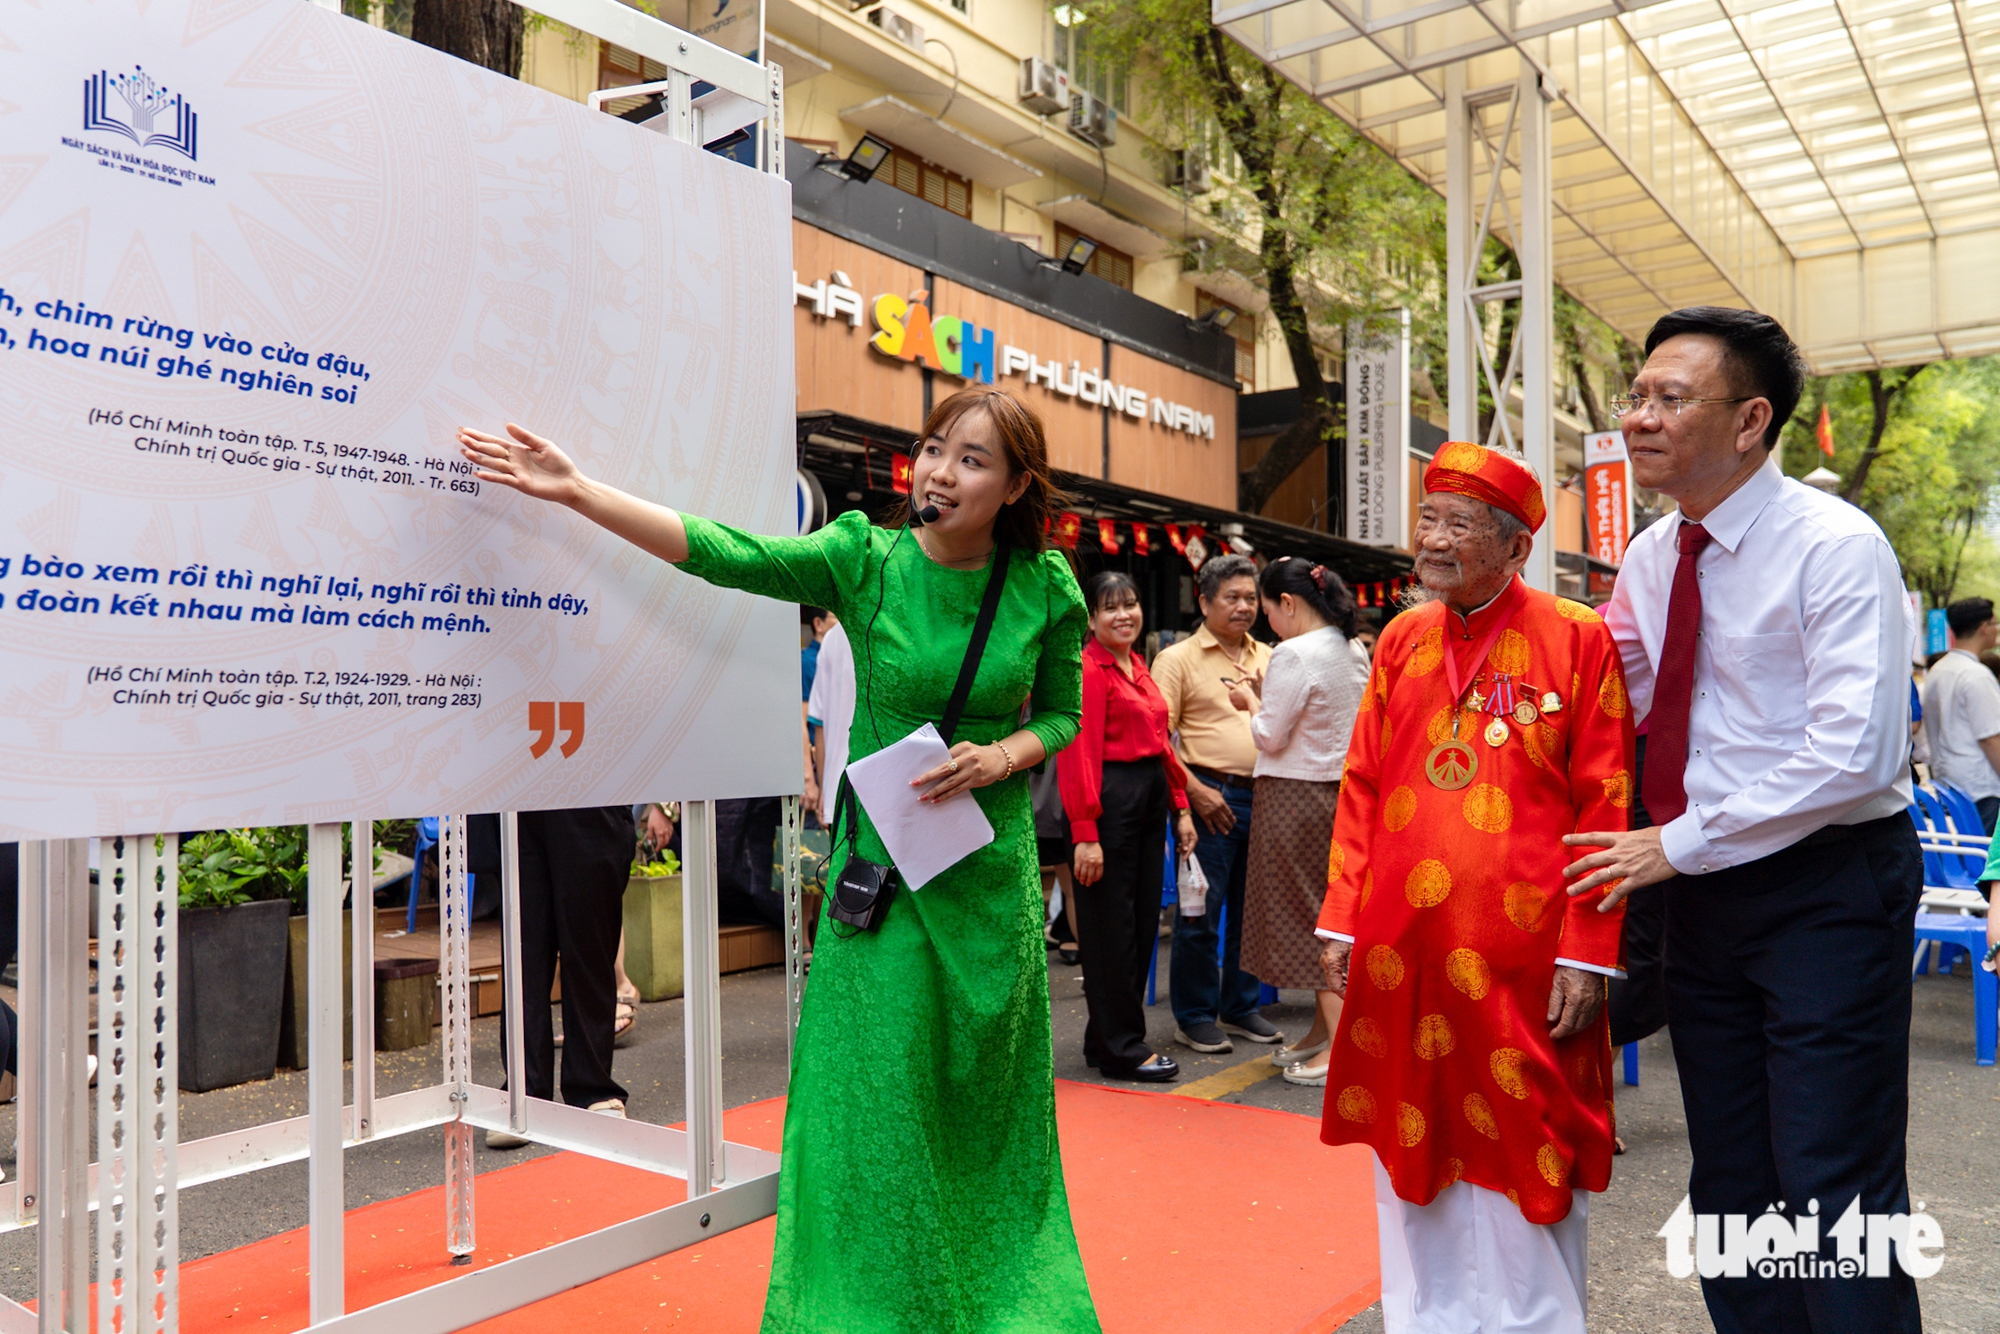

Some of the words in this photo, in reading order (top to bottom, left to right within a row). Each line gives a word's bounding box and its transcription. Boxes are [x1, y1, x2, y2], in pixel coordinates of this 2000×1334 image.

[61, 136, 84, 150] NGÀY
[86, 142, 109, 157] SÁCH
[111, 150, 123, 160] VÀ
[124, 153, 141, 166] VĂN
[143, 158, 160, 171] HÓA
[162, 164, 178, 176] ĐỌC
[179, 168, 197, 181] VIỆT
[198, 174, 216, 186] NAM
[34, 298, 115, 331] chim
[122, 315, 195, 350] rừng
[202, 331, 254, 357] vào
[260, 341, 310, 368] cửa
[316, 352, 371, 383] đậu,
[793, 270, 864, 328] HÀ
[869, 289, 995, 386] SÁCH
[999, 344, 1147, 419] PHƯƠNG
[1150, 396, 1215, 440] NAM
[26, 327, 92, 360] hoa
[99, 345, 151, 370] núi
[155, 354, 213, 380] ghé
[219, 367, 314, 398] nghiên
[320, 384, 359, 405] soi
[1374, 361, 1385, 401] HOUSE
[88, 407, 124, 426] (Hồ
[128, 414, 164, 432] Chí
[166, 419, 214, 439] Minh
[218, 428, 260, 446] toàn
[264, 434, 298, 453] tập.
[302, 439, 328, 458] T.5,
[333, 443, 412, 468] 1947-1948.
[423, 456, 446, 472] Hà
[448, 460, 475, 478] Nội
[1359, 409, 1369, 435] KIM
[1373, 404, 1384, 472] PUBLISHING
[134, 436, 191, 457] Chính
[196, 445, 218, 464] trị
[221, 448, 269, 467] Quốc
[272, 455, 301, 472] gia
[315, 461, 339, 479] Sự
[340, 464, 379, 484] thật,
[381, 469, 416, 487] 2011.
[429, 475, 446, 490] Tr.
[449, 478, 481, 498] 663)
[1373, 474, 1384, 515] DONG
[1356, 508, 1369, 539] NHÀ
[1374, 517, 1384, 539] KIM
[20, 553, 85, 580] bào
[92, 563, 160, 585] xem
[167, 563, 209, 588] rồi
[214, 568, 254, 591] thì
[259, 573, 324, 598] nghĩ
[326, 575, 364, 602] lại,
[370, 581, 428, 605] nghĩ
[430, 582, 462, 604] rồi
[466, 586, 496, 607] thì
[500, 587, 543, 610] tỉnh
[547, 592, 589, 616] dậy,
[15, 588, 101, 615] đoàn
[109, 592, 161, 618] kết
[167, 597, 244, 622] nhau
[250, 602, 295, 624] mà
[301, 604, 351, 627] làm
[357, 608, 416, 630] cách
[421, 612, 491, 637] mệnh.
[87, 664, 123, 685] (Hồ
[128, 666, 164, 683] Chí
[165, 667, 214, 684] Minh
[218, 669, 261, 684] toàn
[265, 669, 299, 688] tập.
[304, 671, 330, 688] T.2,
[335, 671, 412, 687] 1924-1929.
[424, 673, 447, 687] Hà
[449, 673, 476, 691] Nội
[112, 688, 172, 705] Chính
[176, 689, 199, 708] trị
[202, 688, 252, 708] Quốc
[255, 690, 285, 709] gia
[298, 691, 323, 709] Sự
[325, 691, 364, 709] thật,
[367, 692, 402, 708] 2011,
[406, 693, 448, 709] trang
[450, 693, 482, 709] 283)
